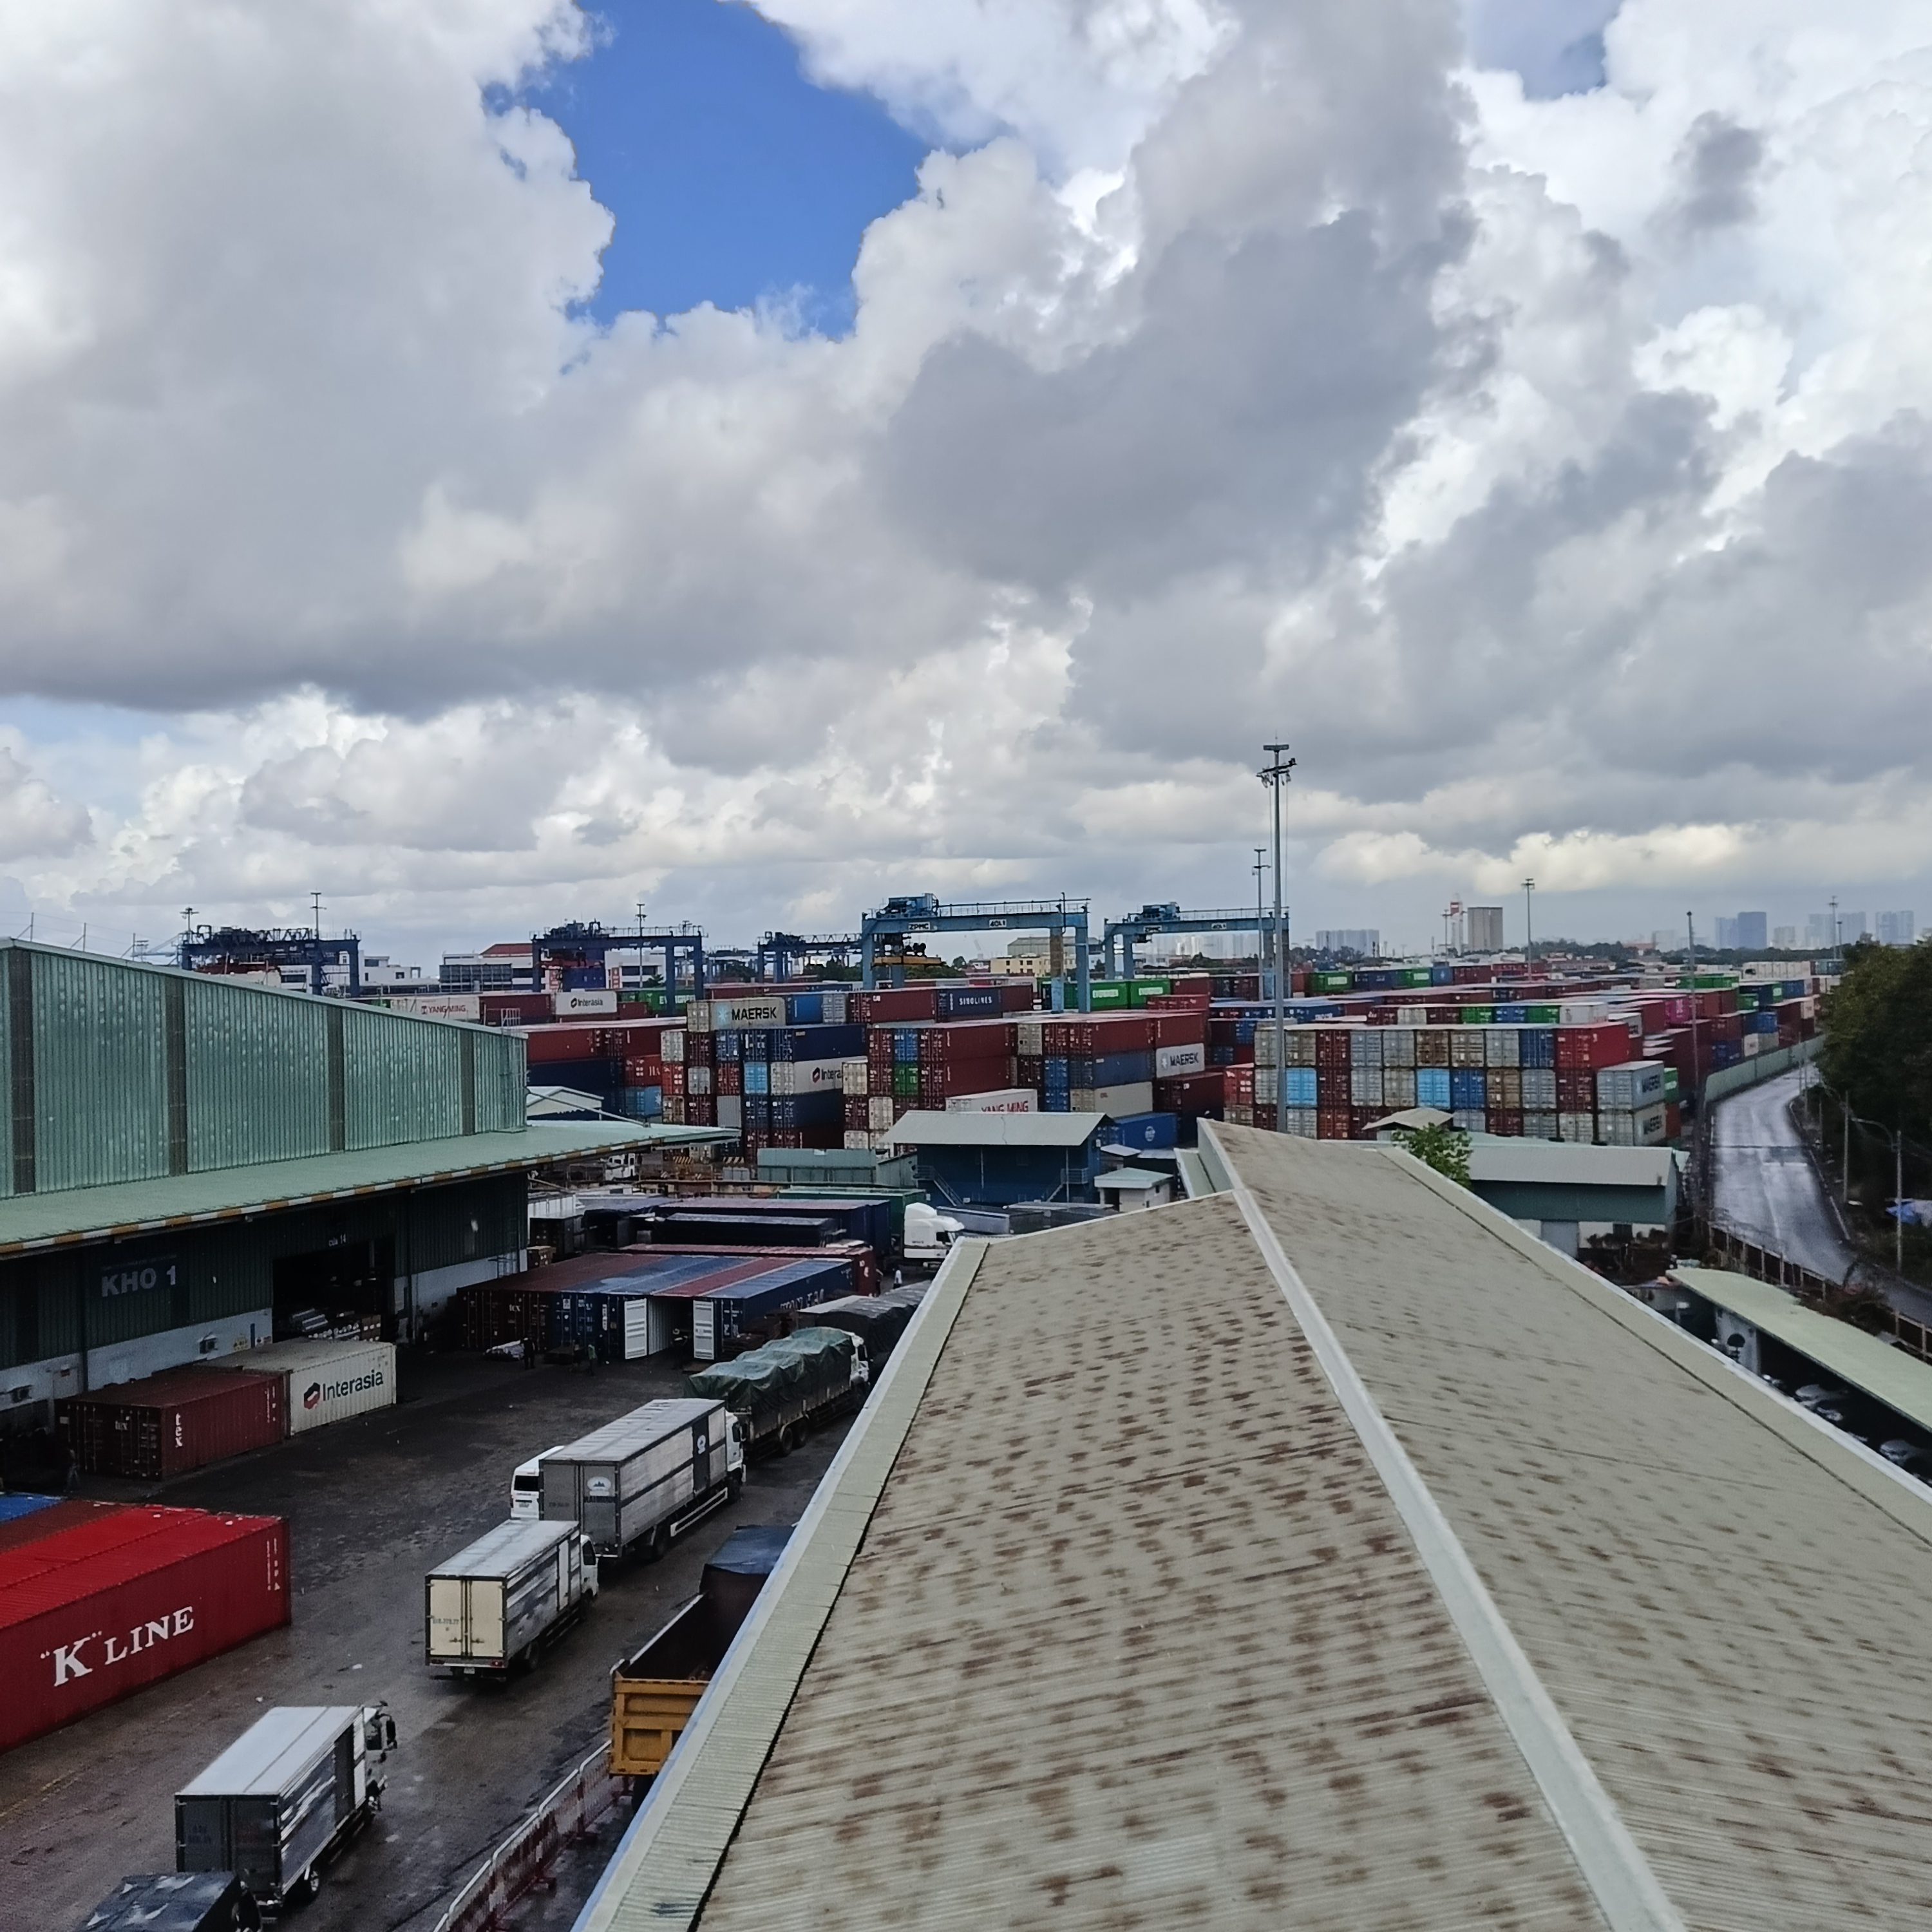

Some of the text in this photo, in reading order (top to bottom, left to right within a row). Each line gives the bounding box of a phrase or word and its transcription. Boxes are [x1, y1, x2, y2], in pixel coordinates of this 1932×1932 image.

[578, 998, 603, 1007] Interasia
[959, 996, 992, 1005] SINOLINES
[732, 1007, 777, 1020] MAERSK
[1170, 1052, 1199, 1066] MAERSK
[101, 1265, 176, 1298] KHO 1
[323, 1368, 384, 1401] Interasia
[104, 1606, 194, 1665] LINE
